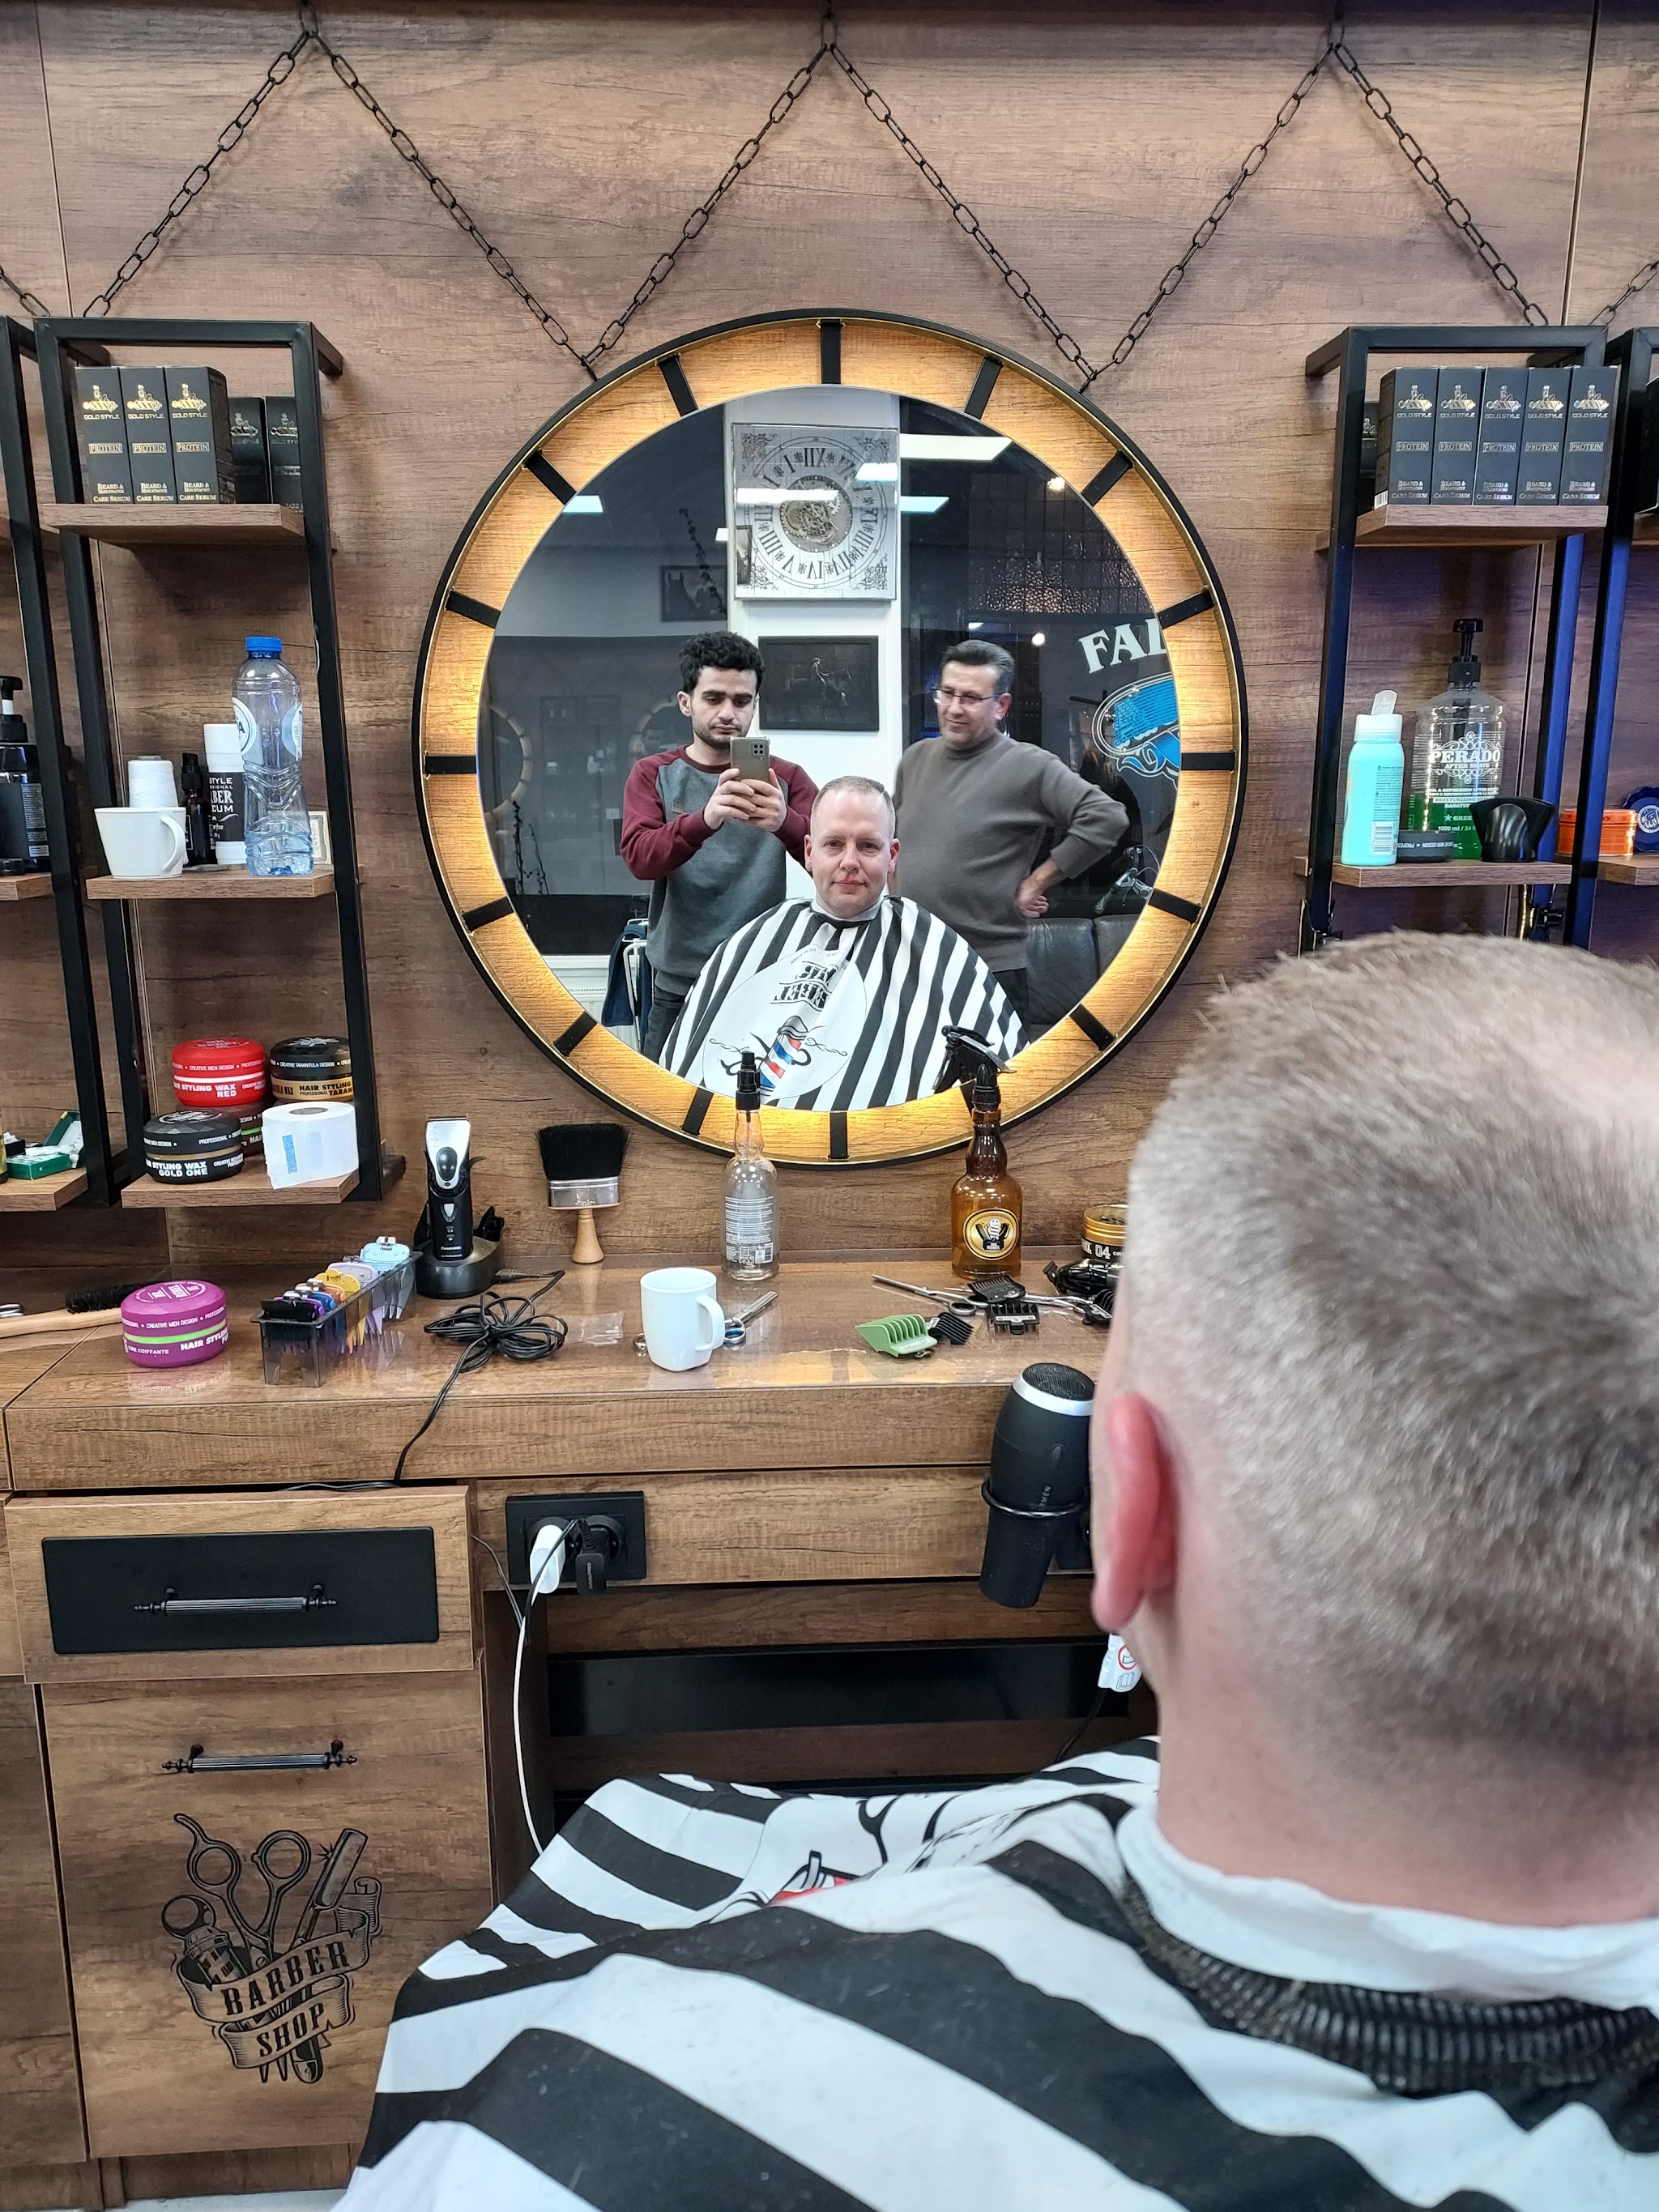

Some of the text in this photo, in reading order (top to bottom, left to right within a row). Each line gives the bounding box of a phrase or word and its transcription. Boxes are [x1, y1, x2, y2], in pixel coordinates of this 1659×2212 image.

[91, 444, 122, 452] PROTEIN
[134, 444, 165, 452] PROTEIN
[178, 443, 208, 451] PROTEIN
[1398, 442, 1428, 450] PROTEIN
[1440, 442, 1471, 450] PROTEIN
[1485, 443, 1515, 451] PROTEIN
[1528, 443, 1557, 451] PROTEIN
[1572, 443, 1602, 451] PROTEIN
[1430, 750, 1500, 763] PERADO
[211, 804, 233, 813] CUM
[181, 1084, 212, 1092] STYLING
[322, 1081, 352, 1090] STYLING
[217, 1090, 237, 1098] RED
[329, 1088, 352, 1096] TARAN
[198, 1135, 228, 1144] PROFESSIONAL
[152, 1161, 182, 1170] STYLING
[184, 1161, 207, 1170] WAX
[186, 1167, 208, 1177] ONE
[1095, 1244, 1111, 1259] 04
[181, 1318, 198, 1326] DESIGN
[180, 1340, 204, 1351] HAIR
[220, 1941, 351, 2016] BARBER
[256, 2002, 324, 2057] SHOP
